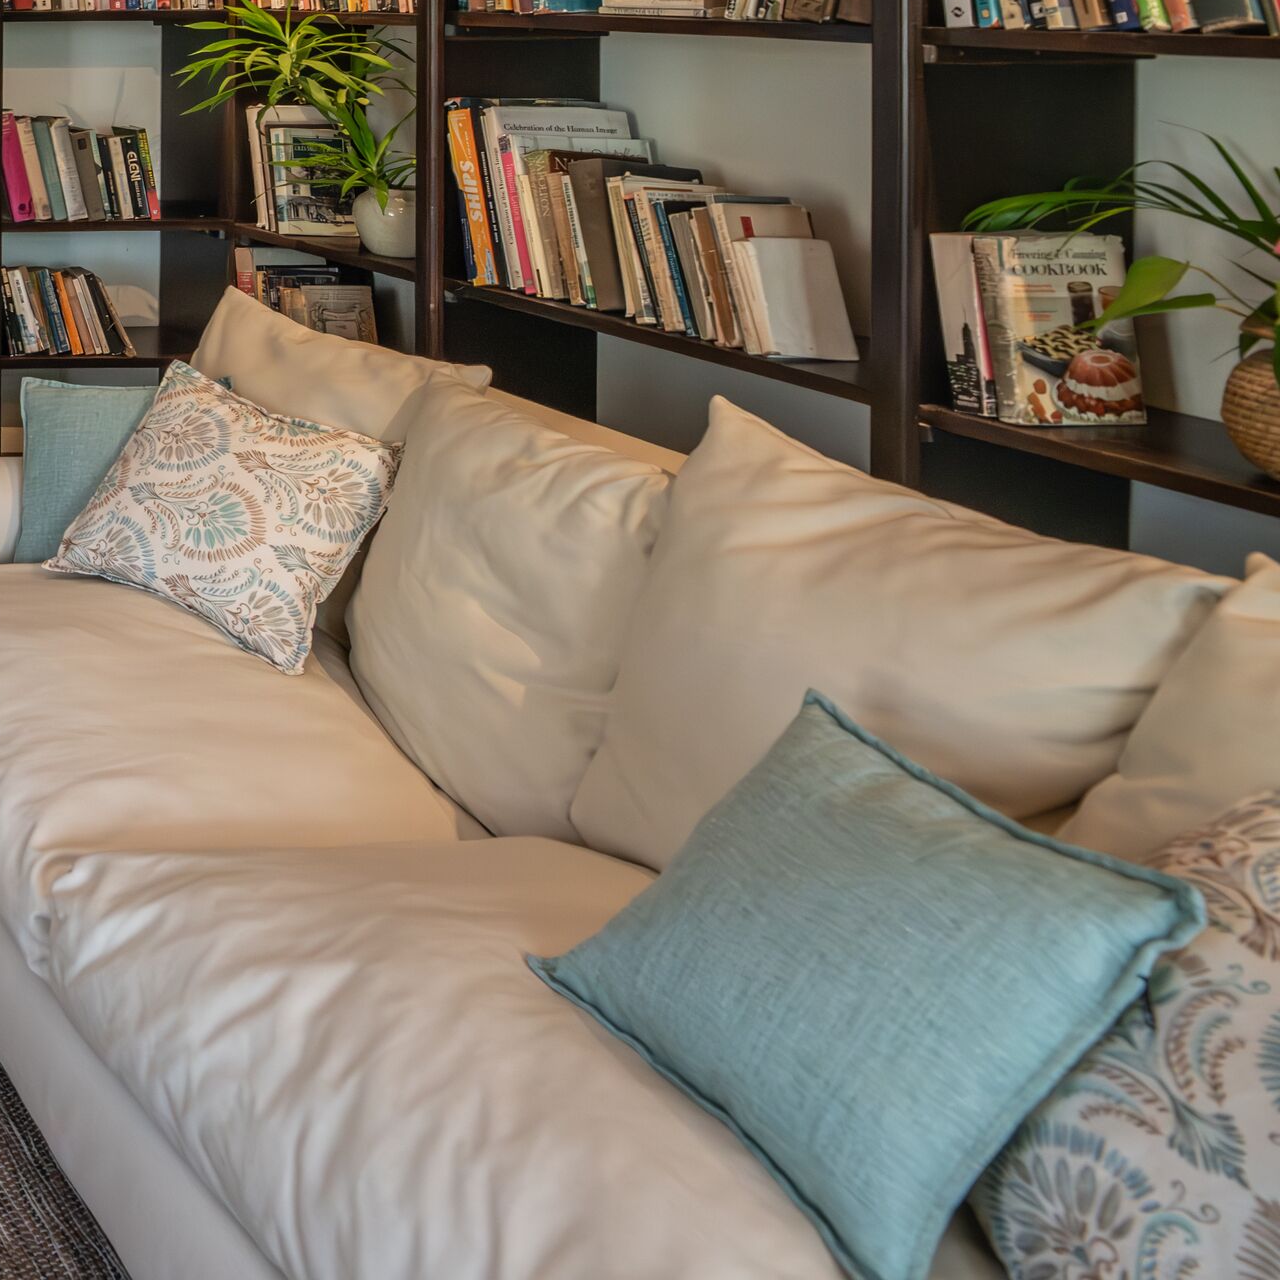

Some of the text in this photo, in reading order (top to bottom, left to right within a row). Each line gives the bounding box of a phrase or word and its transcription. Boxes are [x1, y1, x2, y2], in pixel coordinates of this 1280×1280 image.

[504, 123, 618, 134] Celebration of the Human Image
[126, 151, 141, 182] ELENI
[461, 159, 484, 223] SHIPS
[533, 156, 551, 217] NAPOLEON
[1012, 262, 1108, 277] COOKBOOK
